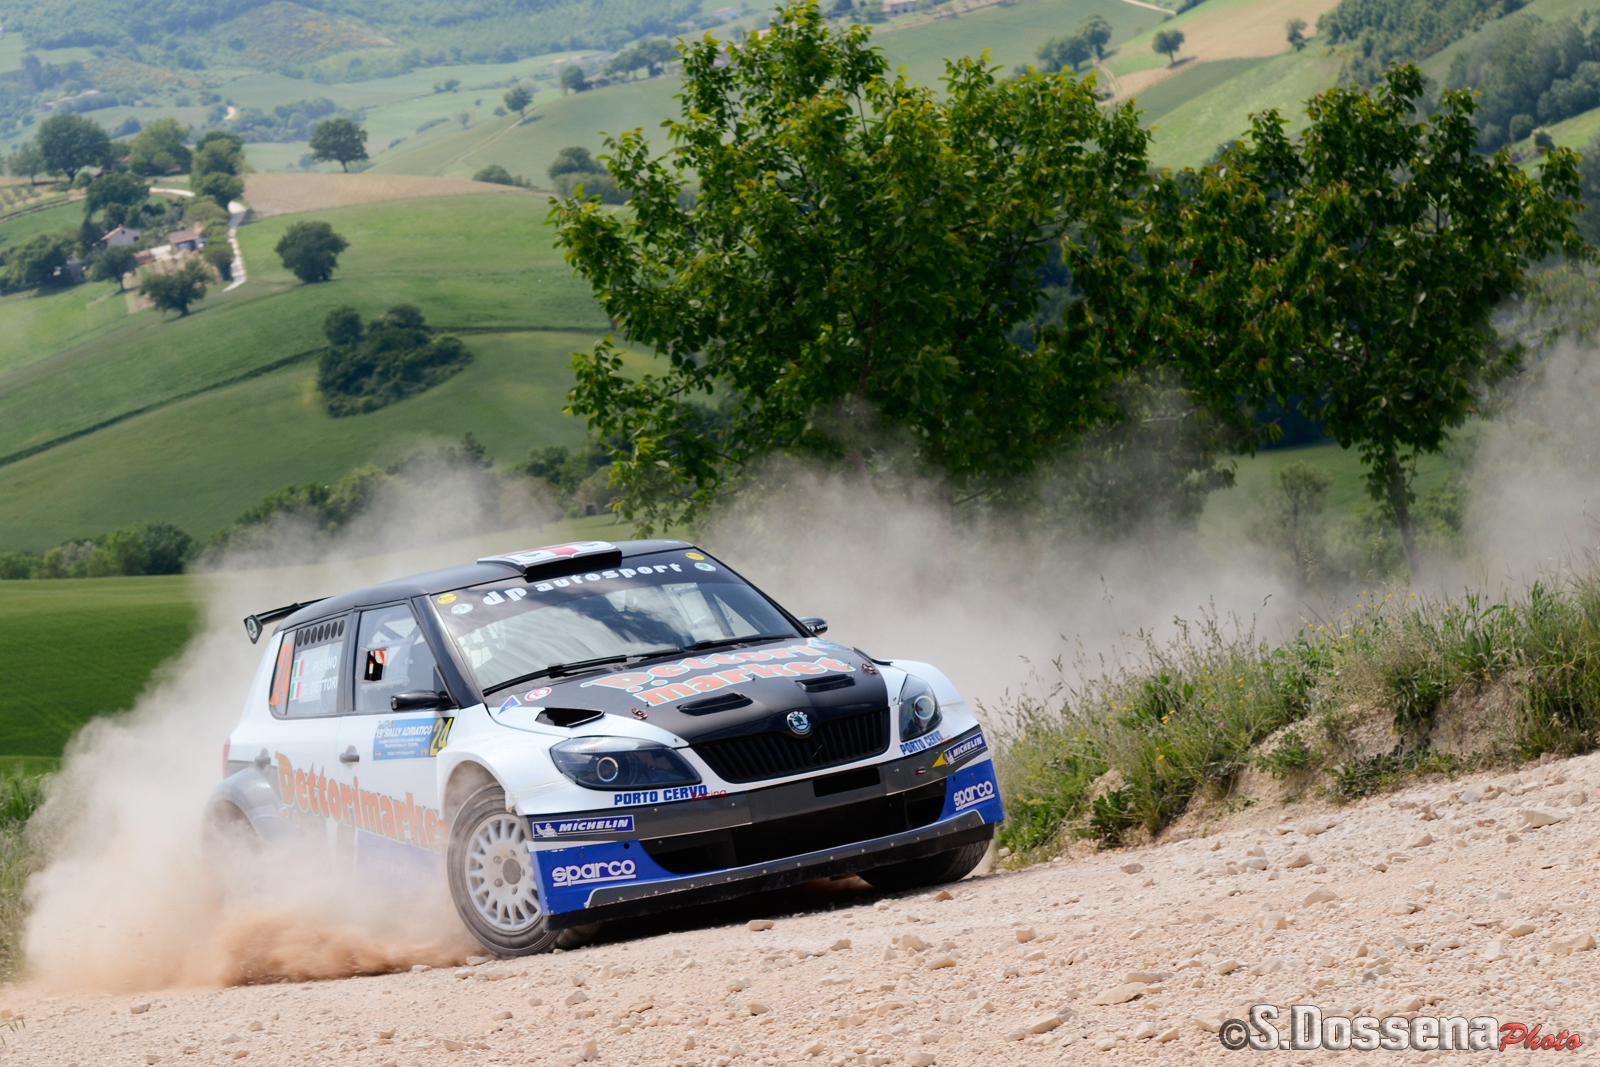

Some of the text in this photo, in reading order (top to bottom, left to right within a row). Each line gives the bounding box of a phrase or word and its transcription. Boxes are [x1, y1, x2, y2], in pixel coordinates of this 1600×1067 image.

[482, 562, 683, 606] dp autosport
[269, 642, 294, 706] 24
[313, 655, 338, 672] PISANO
[579, 644, 828, 690] Dettori
[309, 675, 338, 694] DETTORI
[632, 657, 856, 707] market
[384, 726, 402, 738] RALLY
[401, 725, 433, 737] ADRIATICO
[429, 717, 454, 757] 24
[899, 738, 926, 755] PORTO
[923, 730, 944, 747] CERVO
[953, 736, 983, 757] MICHELIN
[614, 784, 708, 806] PORTO CERVO
[953, 780, 994, 810] sparco
[558, 818, 629, 832] MICHELIN
[551, 858, 636, 887] sparco
